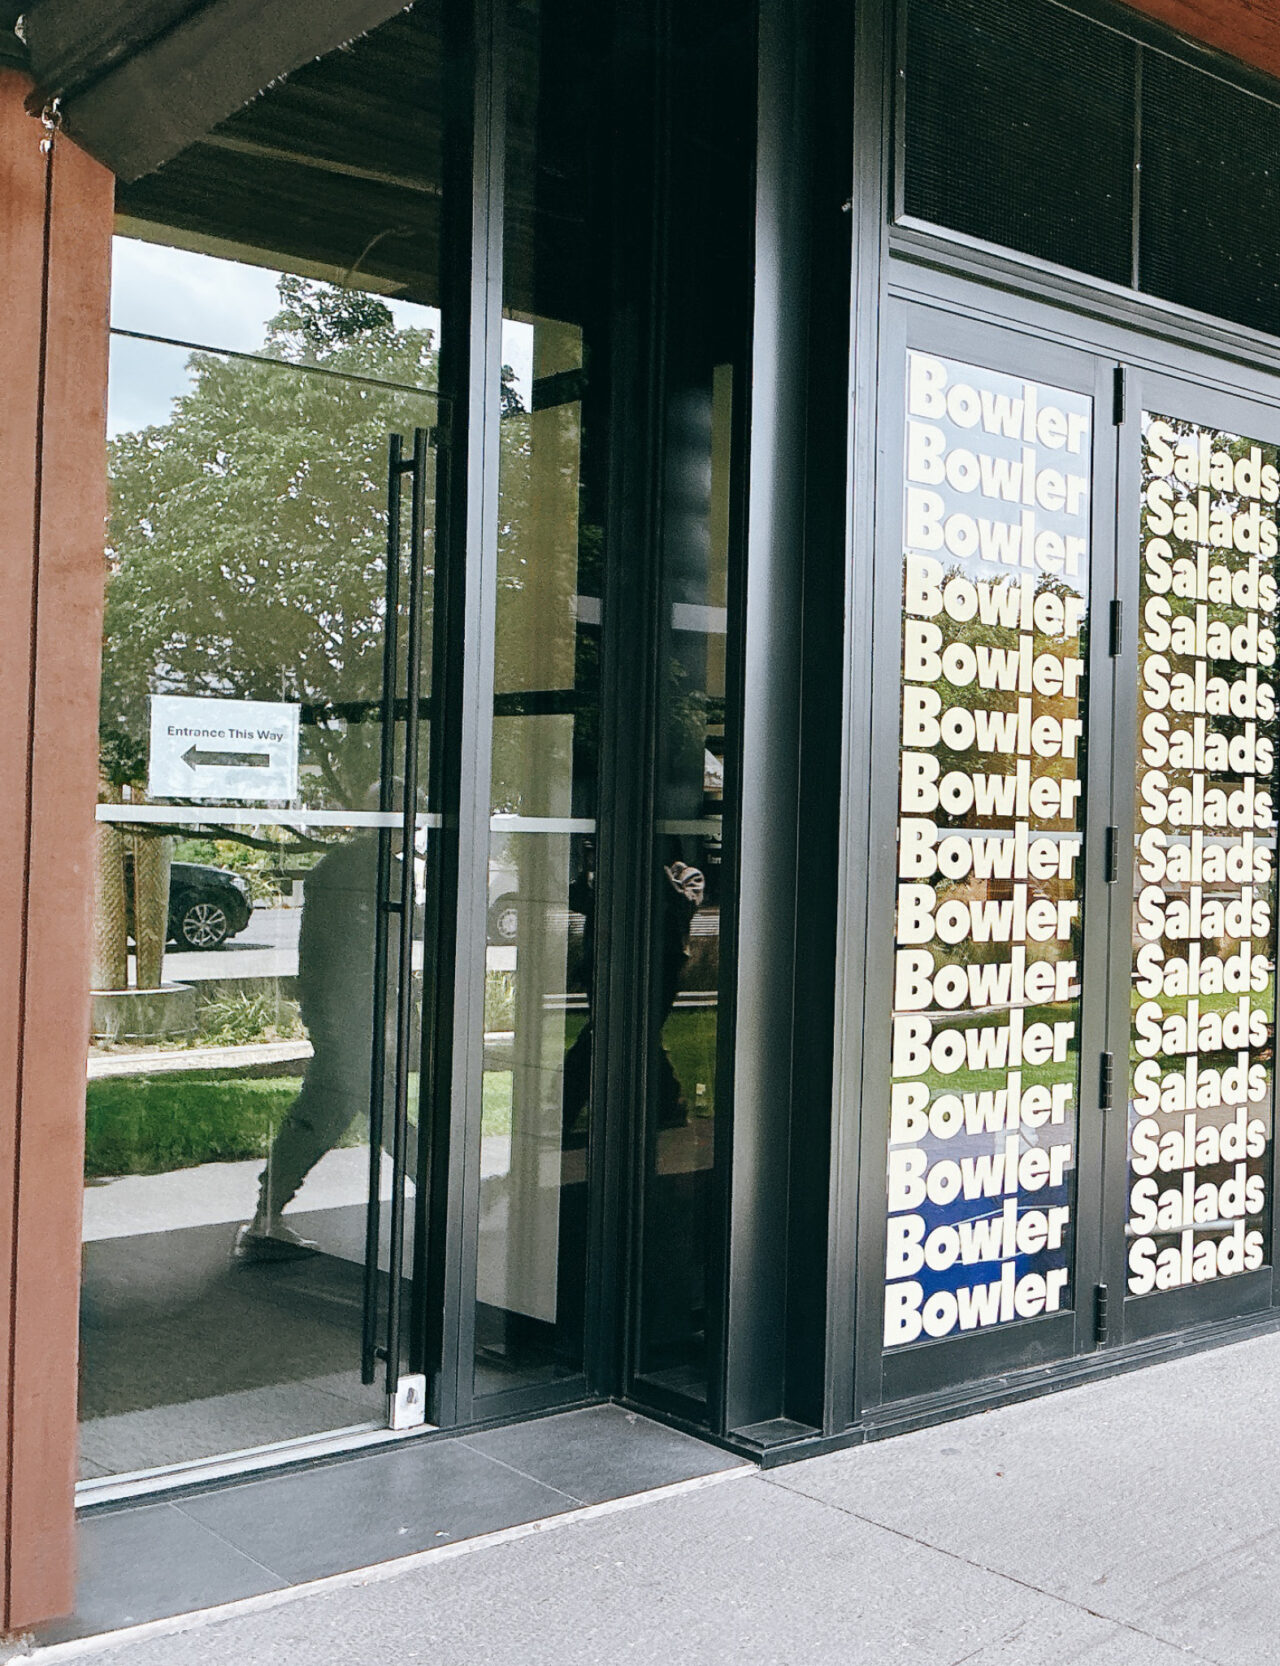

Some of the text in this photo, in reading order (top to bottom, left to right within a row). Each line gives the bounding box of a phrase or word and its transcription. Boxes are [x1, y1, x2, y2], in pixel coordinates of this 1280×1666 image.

[909, 354, 1086, 454] Bowler
[1147, 421, 1280, 502] Salads
[908, 420, 1085, 514] Bowler
[1146, 479, 1279, 556] Salads
[906, 486, 1084, 574] Bowler
[1144, 538, 1277, 610] Salads
[905, 553, 1084, 635] Bowler
[1144, 596, 1276, 664] Salads
[903, 619, 1082, 696] Bowler
[1142, 654, 1275, 719] Salads
[167, 725, 284, 742] Entrance This Way
[901, 685, 1081, 756] Bowler
[1141, 712, 1274, 773] Salads
[900, 751, 1080, 817] Bowler
[1140, 770, 1272, 828] Salads
[898, 818, 1080, 879] Bowler
[1138, 830, 1271, 882] Salads
[896, 884, 1077, 945] Bowler
[1137, 885, 1270, 940] Salads
[894, 946, 1076, 1011] Bowler
[1136, 941, 1269, 998] Salads
[892, 1009, 1075, 1078] Bowler
[1134, 997, 1267, 1058] Salads
[891, 1072, 1073, 1145] Bowler
[1133, 1051, 1266, 1116] Salads
[888, 1136, 1071, 1212] Bowler
[1130, 1107, 1265, 1176] Salads
[886, 1198, 1070, 1279] Bowler
[1129, 1163, 1264, 1235] Salads
[883, 1262, 1067, 1346] Bowler
[1128, 1219, 1262, 1295] Salads
